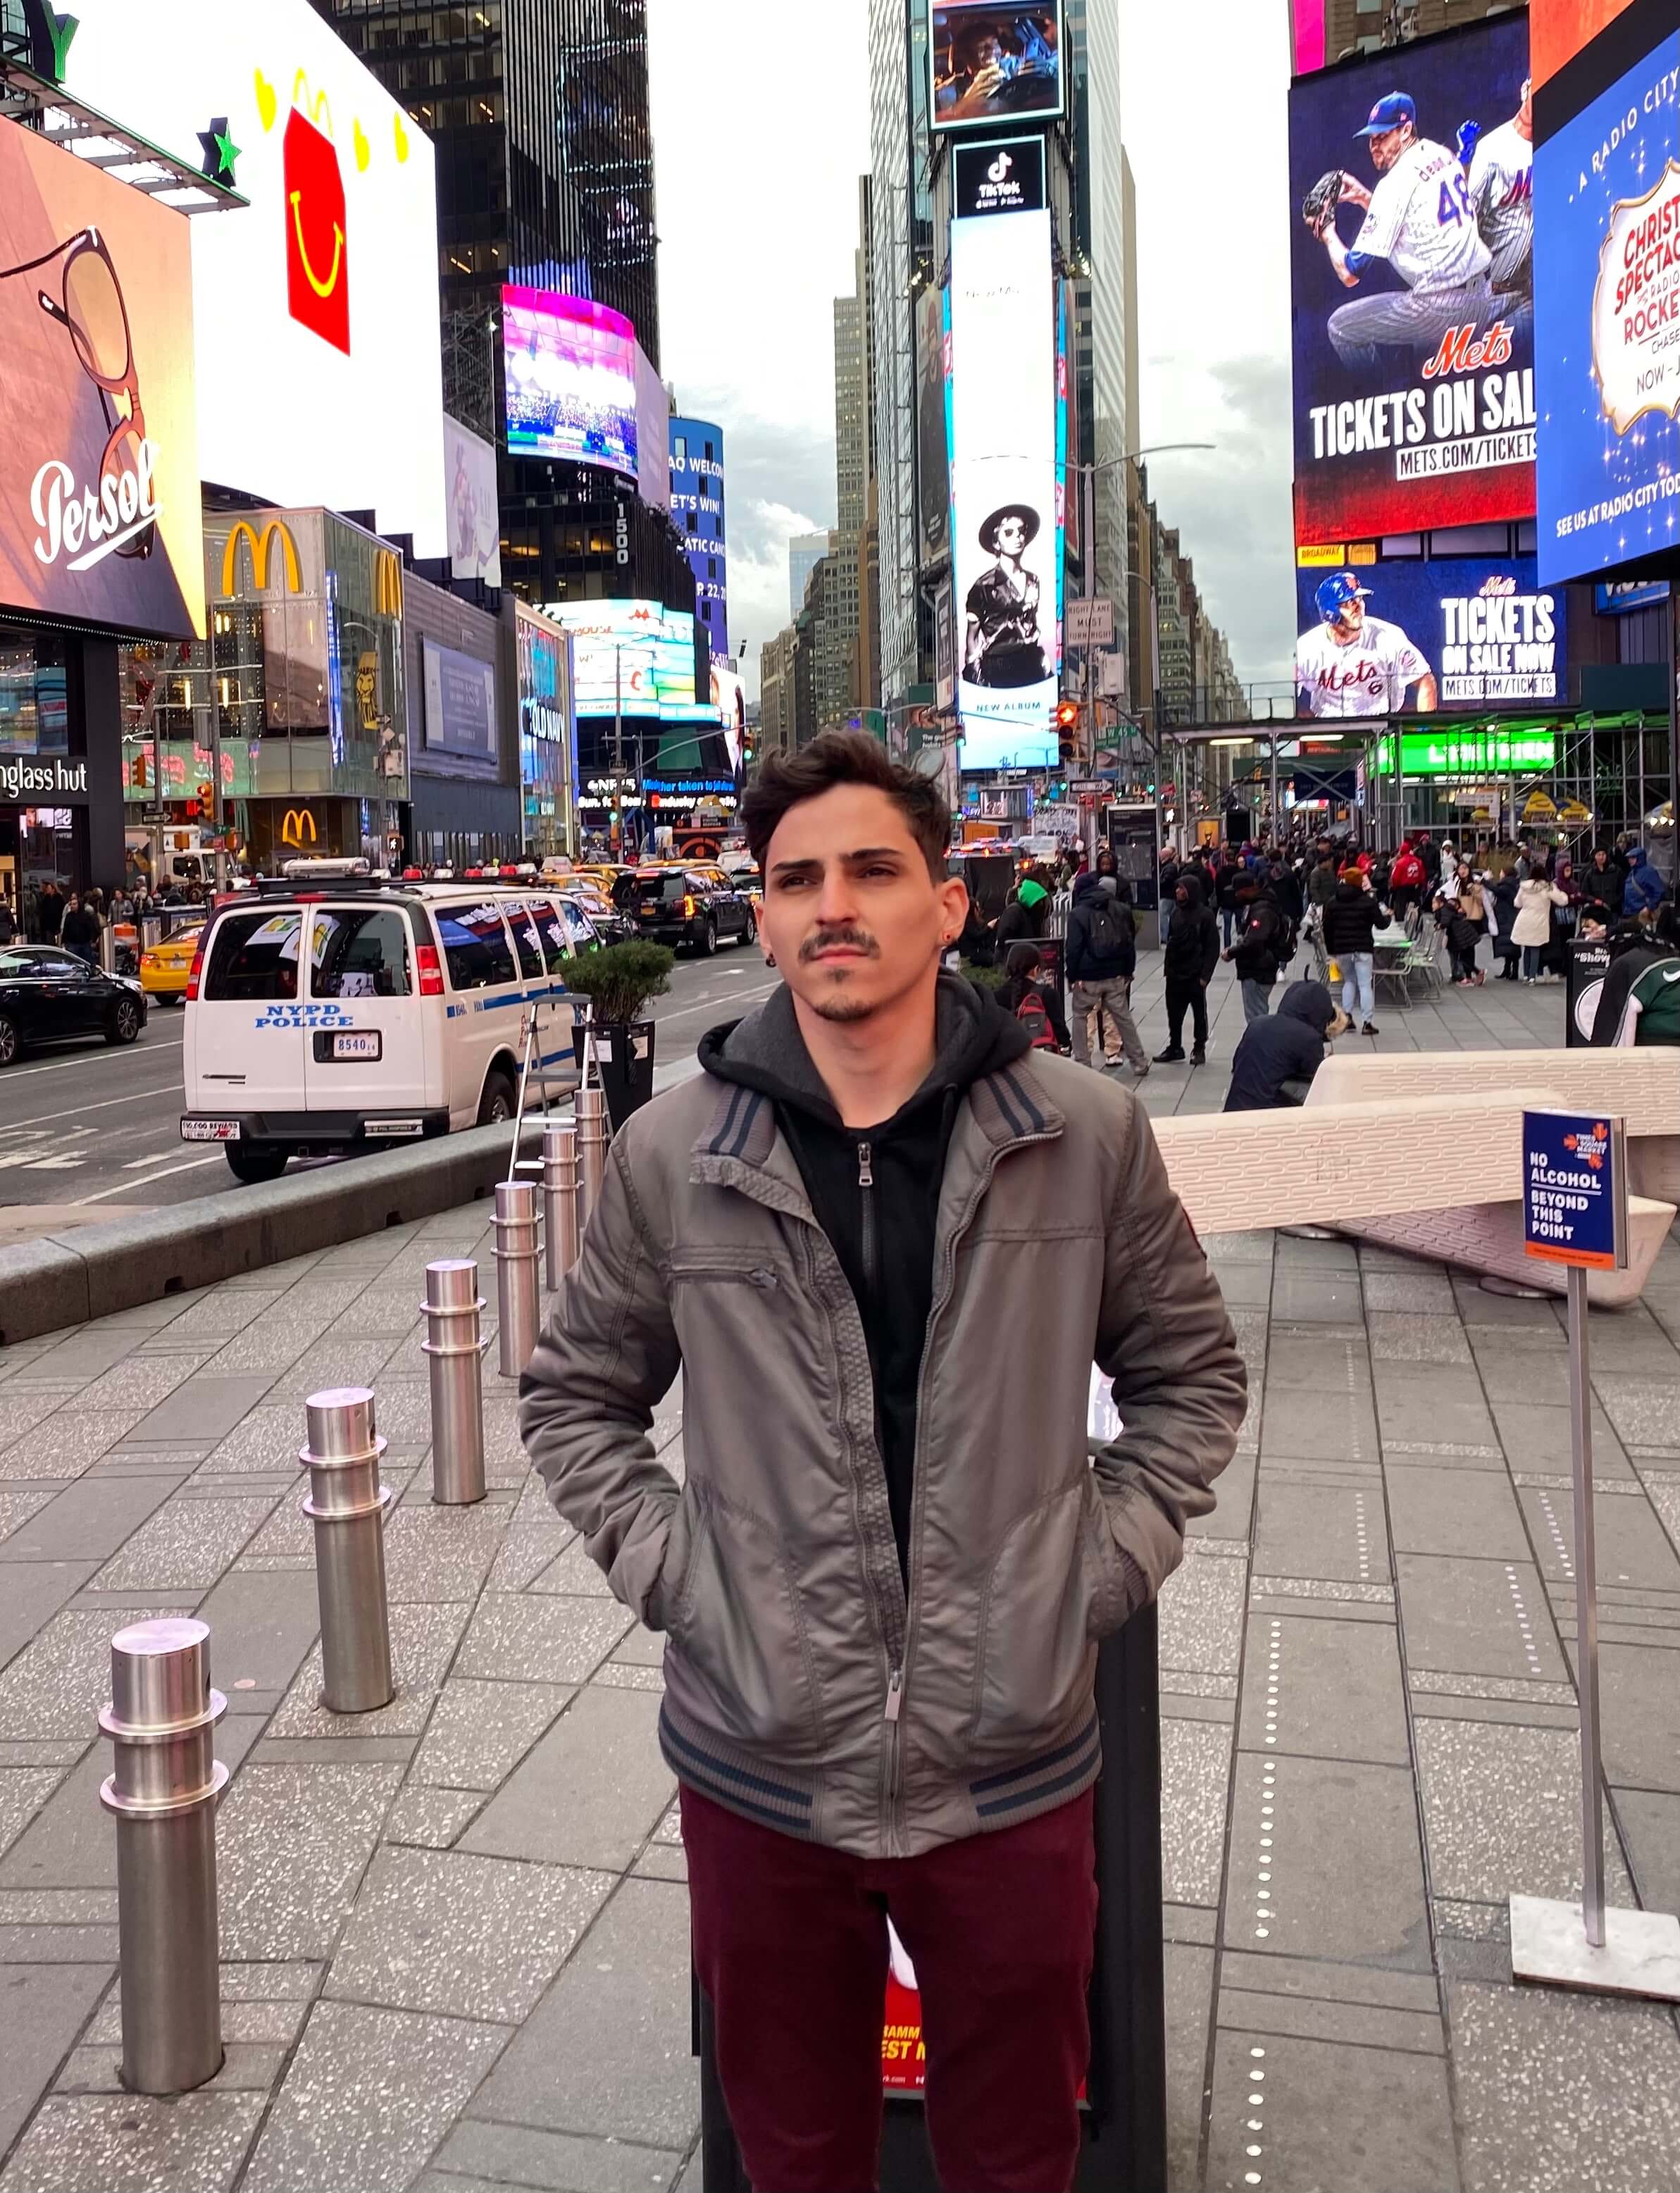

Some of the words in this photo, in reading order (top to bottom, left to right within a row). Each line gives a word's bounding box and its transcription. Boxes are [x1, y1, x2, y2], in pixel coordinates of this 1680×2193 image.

[1579, 172, 1588, 193] A
[1592, 108, 1637, 173] RADIO
[1643, 66, 1680, 113] CITY
[1421, 321, 1515, 380] Mets
[1636, 364, 1664, 395] NOW
[1309, 387, 1427, 459] TICKETS
[1433, 378, 1476, 440] ON
[30, 438, 163, 564] Persol
[699, 497, 720, 515] WIN!
[1556, 515, 1572, 538] SEE
[1574, 509, 1586, 530] US
[1588, 504, 1600, 527] AT
[1601, 491, 1634, 521] RADIO
[1634, 482, 1658, 509] CITY
[616, 502, 628, 564] 1500
[1068, 606, 1089, 614] RIGHT
[1441, 595, 1555, 645] TICKETS
[1077, 617, 1101, 627] MUST
[1443, 645, 1467, 675] ON
[1469, 644, 1512, 674] SALE
[1514, 642, 1555, 673] NOW
[1317, 659, 1377, 690] Mets
[1368, 681, 1383, 695] 6
[976, 704, 1000, 712] NEW
[1004, 702, 1041, 711] ALBUM
[532, 704, 547, 739] OLD
[547, 709, 564, 743] NAVY
[57, 759, 87, 792] hut
[266, 1005, 341, 1016] NYPD
[255, 1016, 354, 1028] POLICE
[338, 1038, 366, 1050] 8540
[1529, 1151, 1548, 1167] NO
[1531, 1167, 1602, 1189] ALCOHOL
[1531, 1189, 1588, 1211] BEYOND
[1531, 1205, 1563, 1224] THIS
[1532, 1220, 1574, 1241] POINT
